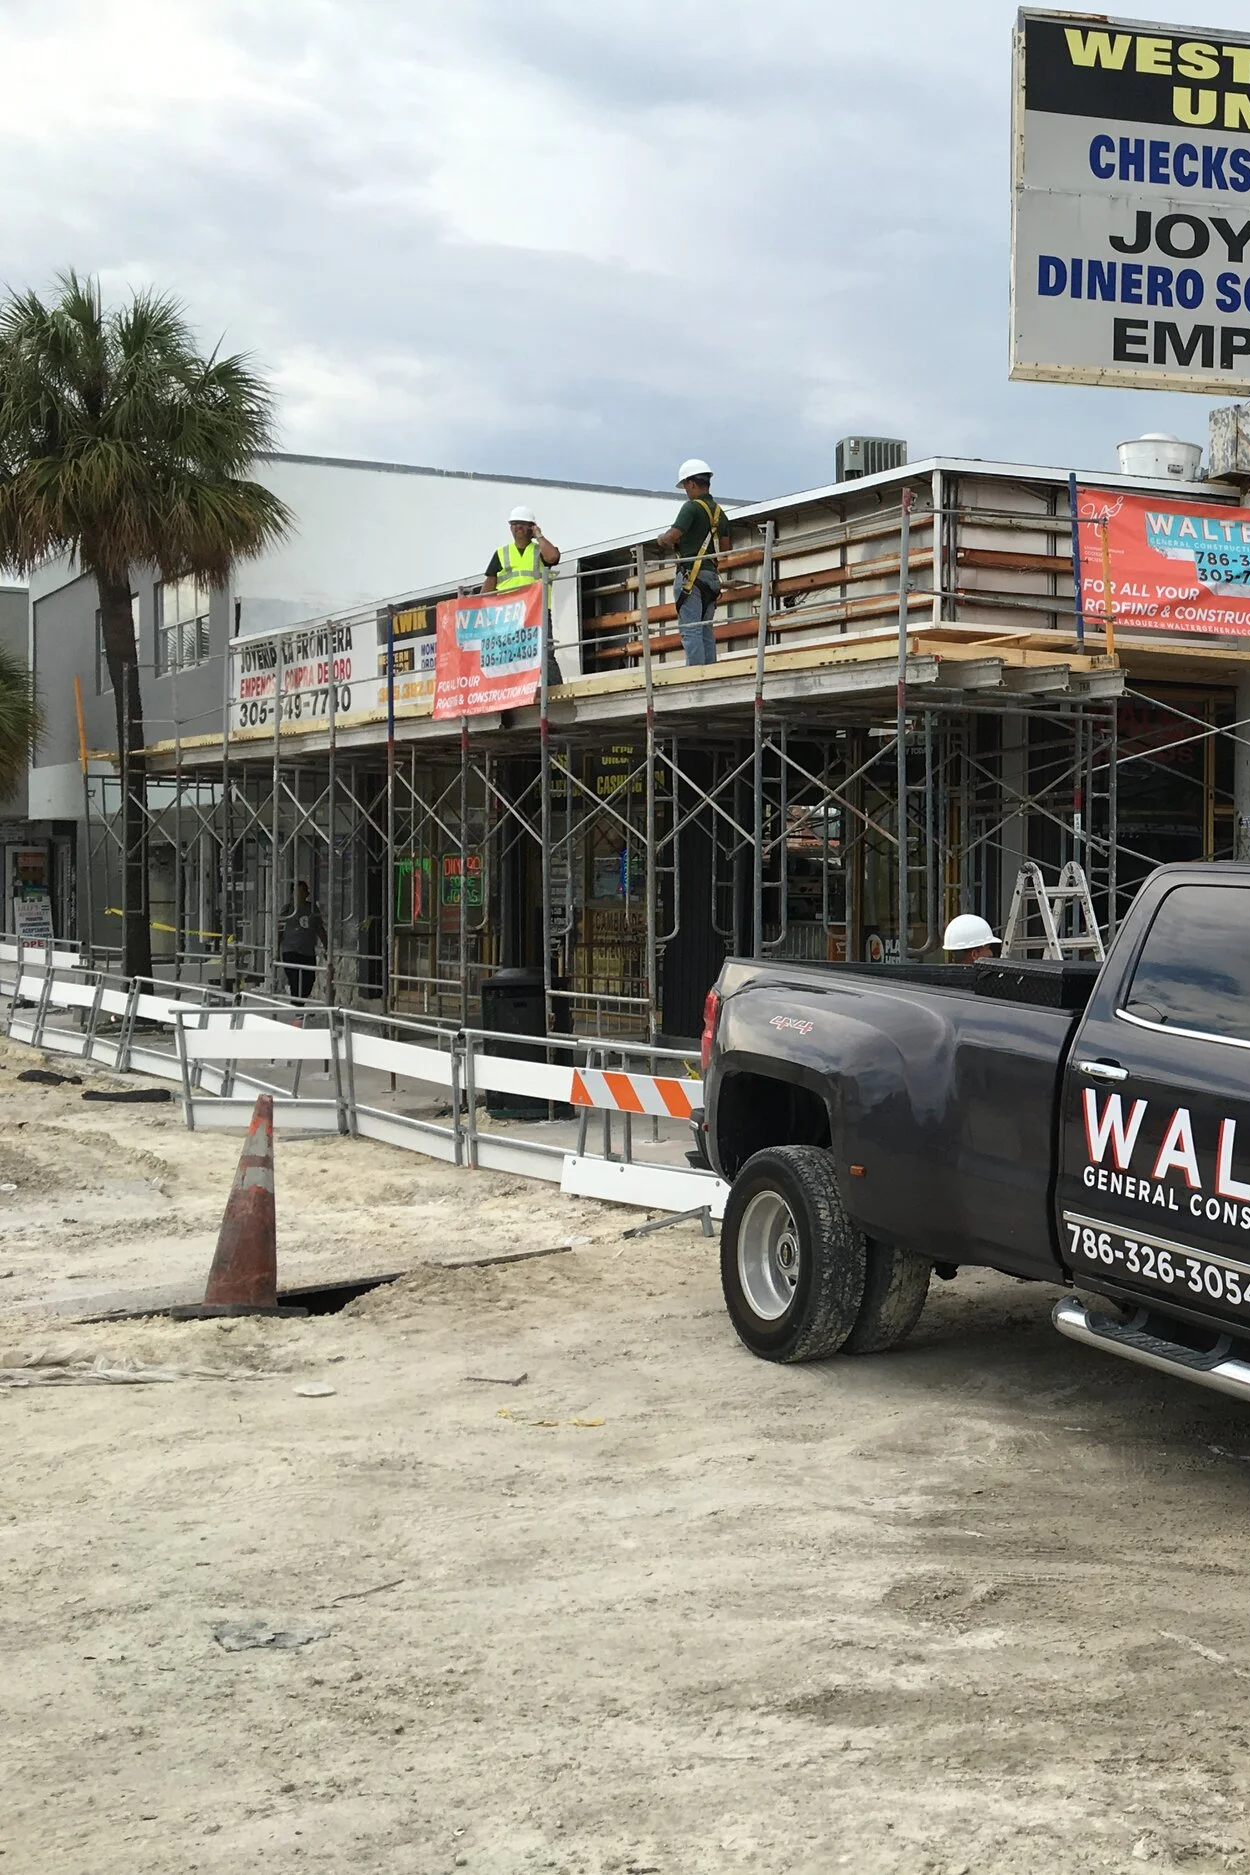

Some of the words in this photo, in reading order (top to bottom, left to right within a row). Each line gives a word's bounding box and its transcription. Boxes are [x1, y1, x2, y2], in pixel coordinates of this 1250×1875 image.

[1038, 255, 1203, 310] DINERO
[1150, 537, 1191, 548] GENERAL
[1084, 578, 1116, 594] FOR
[1120, 583, 1150, 597] ALL
[1156, 585, 1200, 601] YOUR
[455, 604, 521, 630] WALTER
[1085, 598, 1159, 616] ROOFING
[1161, 605, 1171, 618] &
[240, 684, 352, 718] 305-49-770
[445, 856, 480, 876] DINRO
[23, 940, 44, 949] OPE
[1083, 1165, 1180, 1211] GENERAL
